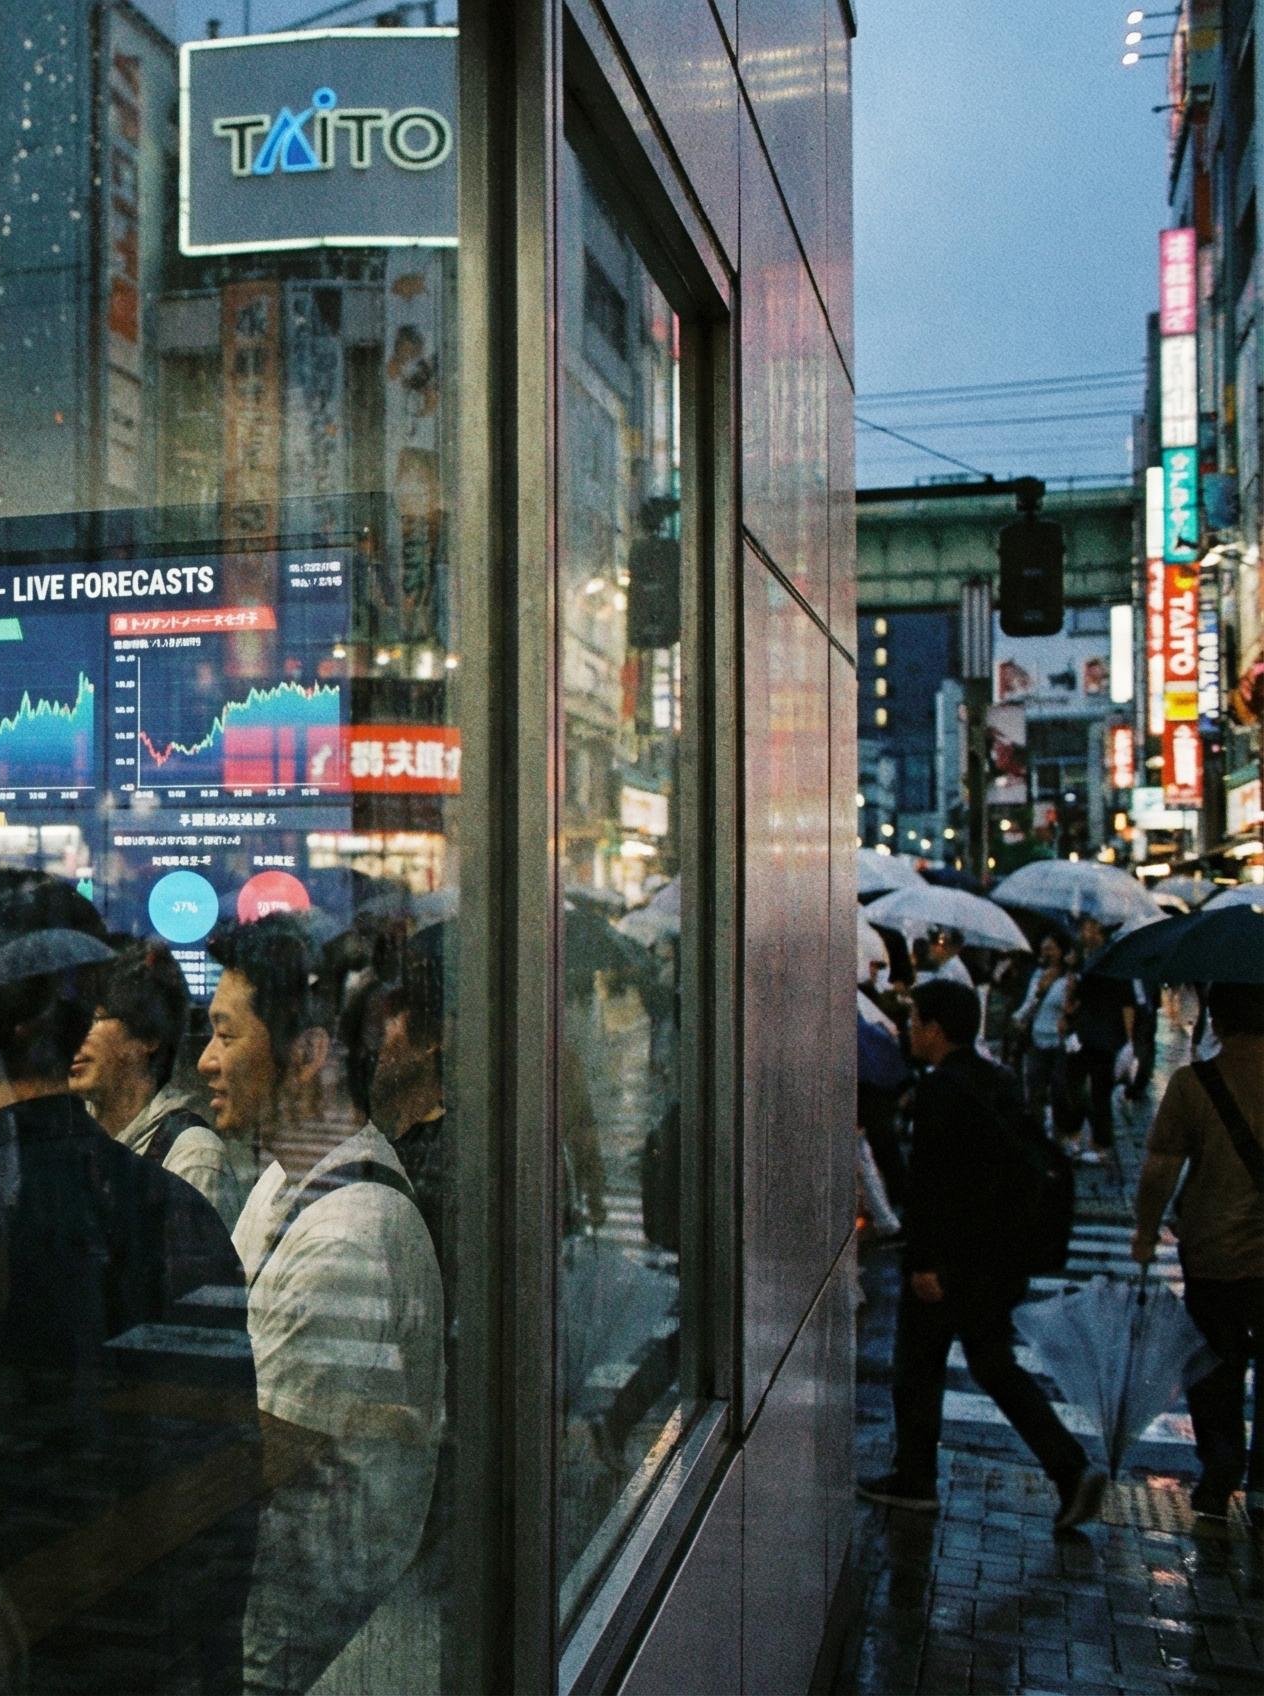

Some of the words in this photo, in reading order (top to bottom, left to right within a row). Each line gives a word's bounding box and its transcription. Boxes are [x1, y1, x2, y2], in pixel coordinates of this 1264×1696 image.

[213, 86, 454, 177] TAITO
[13, 574, 65, 602] LIVE
[70, 565, 214, 599] FORECASTS
[1169, 591, 1196, 675] TAITO
